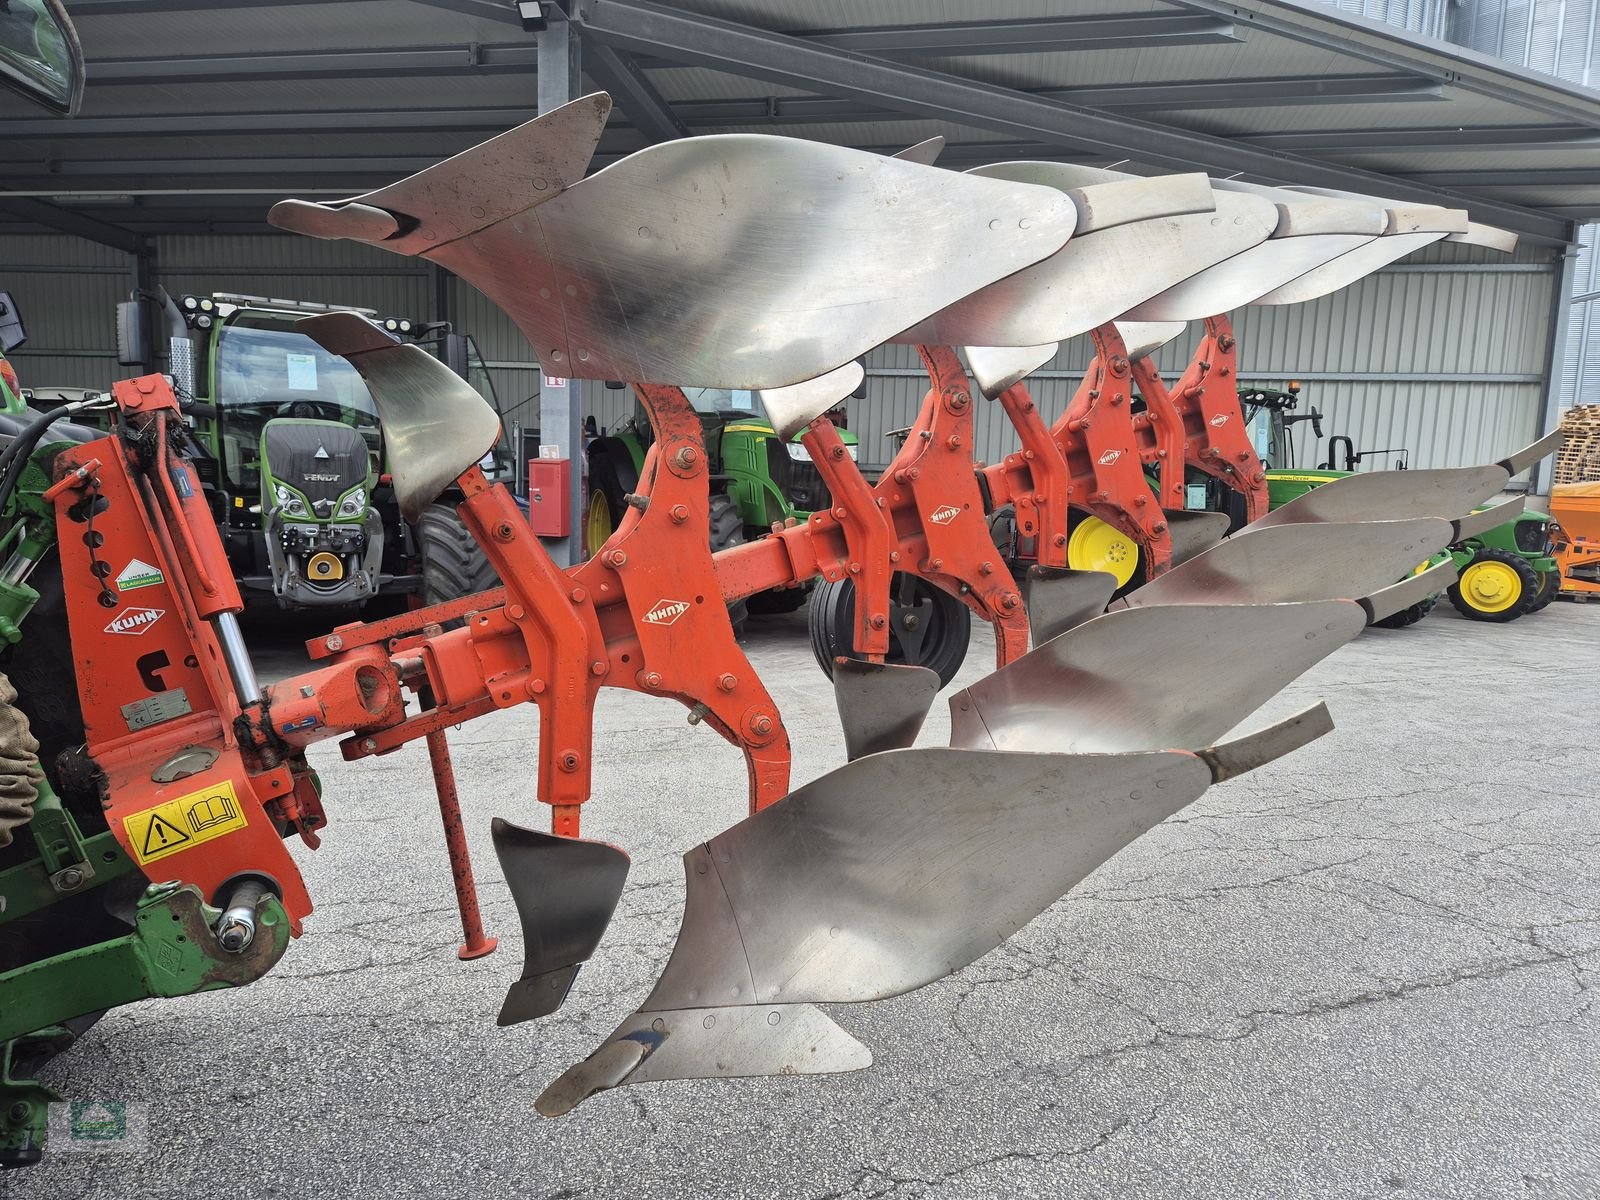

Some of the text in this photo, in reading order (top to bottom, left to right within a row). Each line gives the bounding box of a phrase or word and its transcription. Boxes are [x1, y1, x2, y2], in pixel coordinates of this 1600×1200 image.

[1101, 451, 1119, 463] KUHN
[304, 473, 340, 482] FENDT
[932, 508, 957, 522] KUHN
[128, 572, 150, 580] UNSER
[648, 603, 685, 622] KUHN
[111, 609, 158, 632] KUHN
